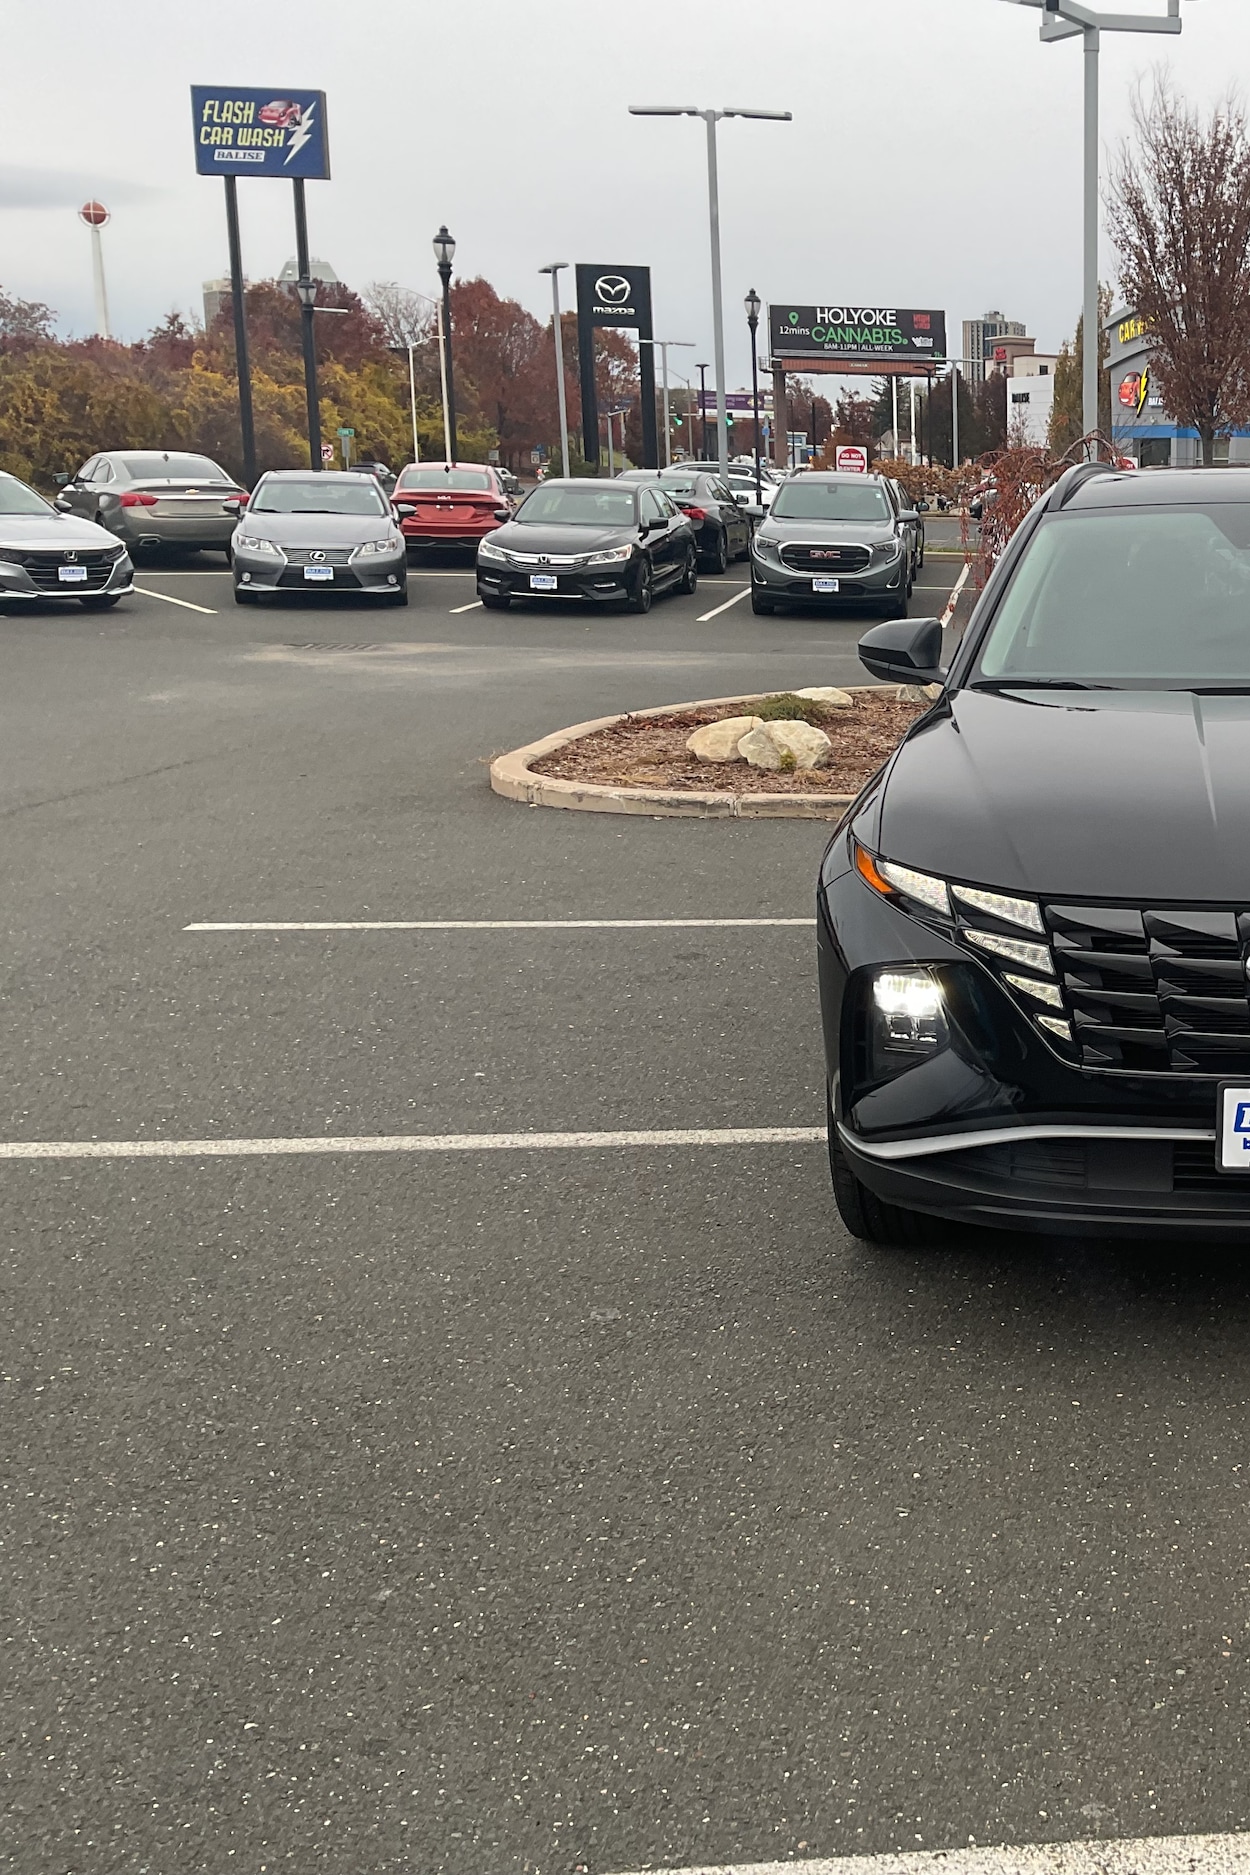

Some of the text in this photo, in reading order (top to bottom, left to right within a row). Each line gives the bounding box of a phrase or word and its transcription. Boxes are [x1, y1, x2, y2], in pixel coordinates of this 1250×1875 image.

[202, 100, 255, 124] FLASH
[200, 126, 285, 147] CAR WASH
[216, 151, 263, 160] BALISE
[816, 307, 897, 326] HOLYOKE
[779, 326, 810, 335] 12mins
[1118, 319, 1135, 343] CAR
[810, 550, 841, 559] GMC
